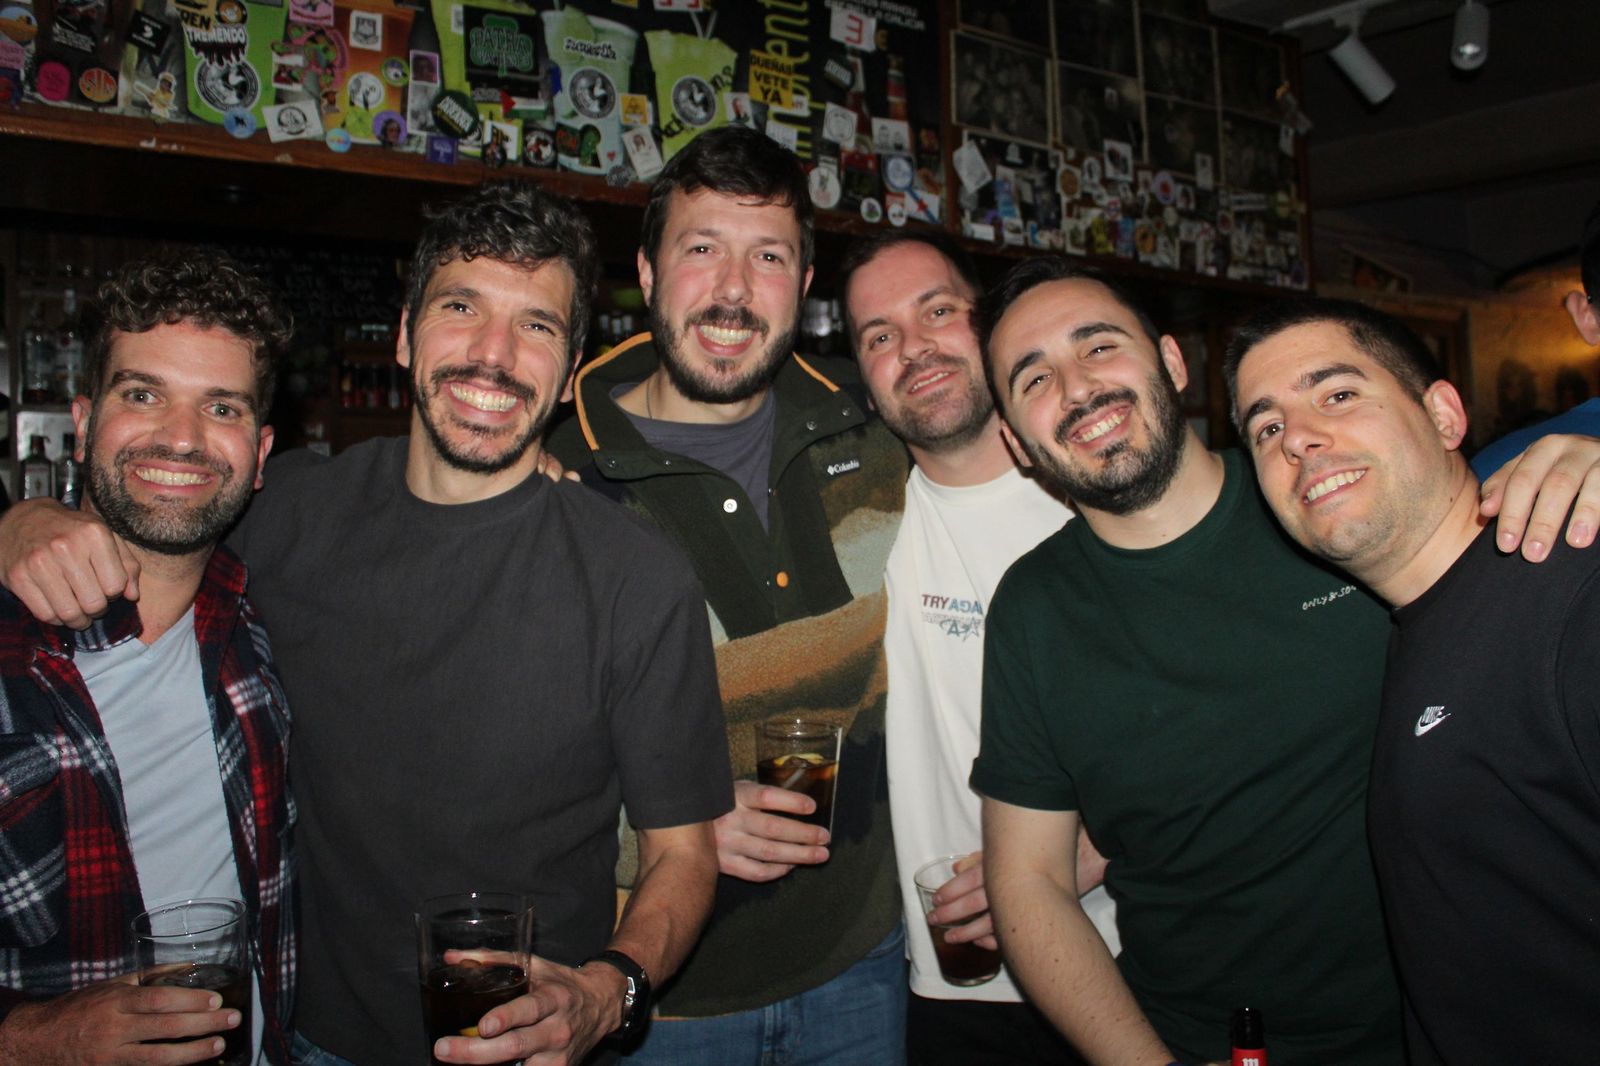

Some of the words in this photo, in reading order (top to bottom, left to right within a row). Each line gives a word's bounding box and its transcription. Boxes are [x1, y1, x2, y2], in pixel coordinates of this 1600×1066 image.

[187, 26, 246, 43] TREMENDO
[754, 69, 789, 91] VETE
[759, 85, 783, 105] YA
[834, 459, 860, 473] Columbia
